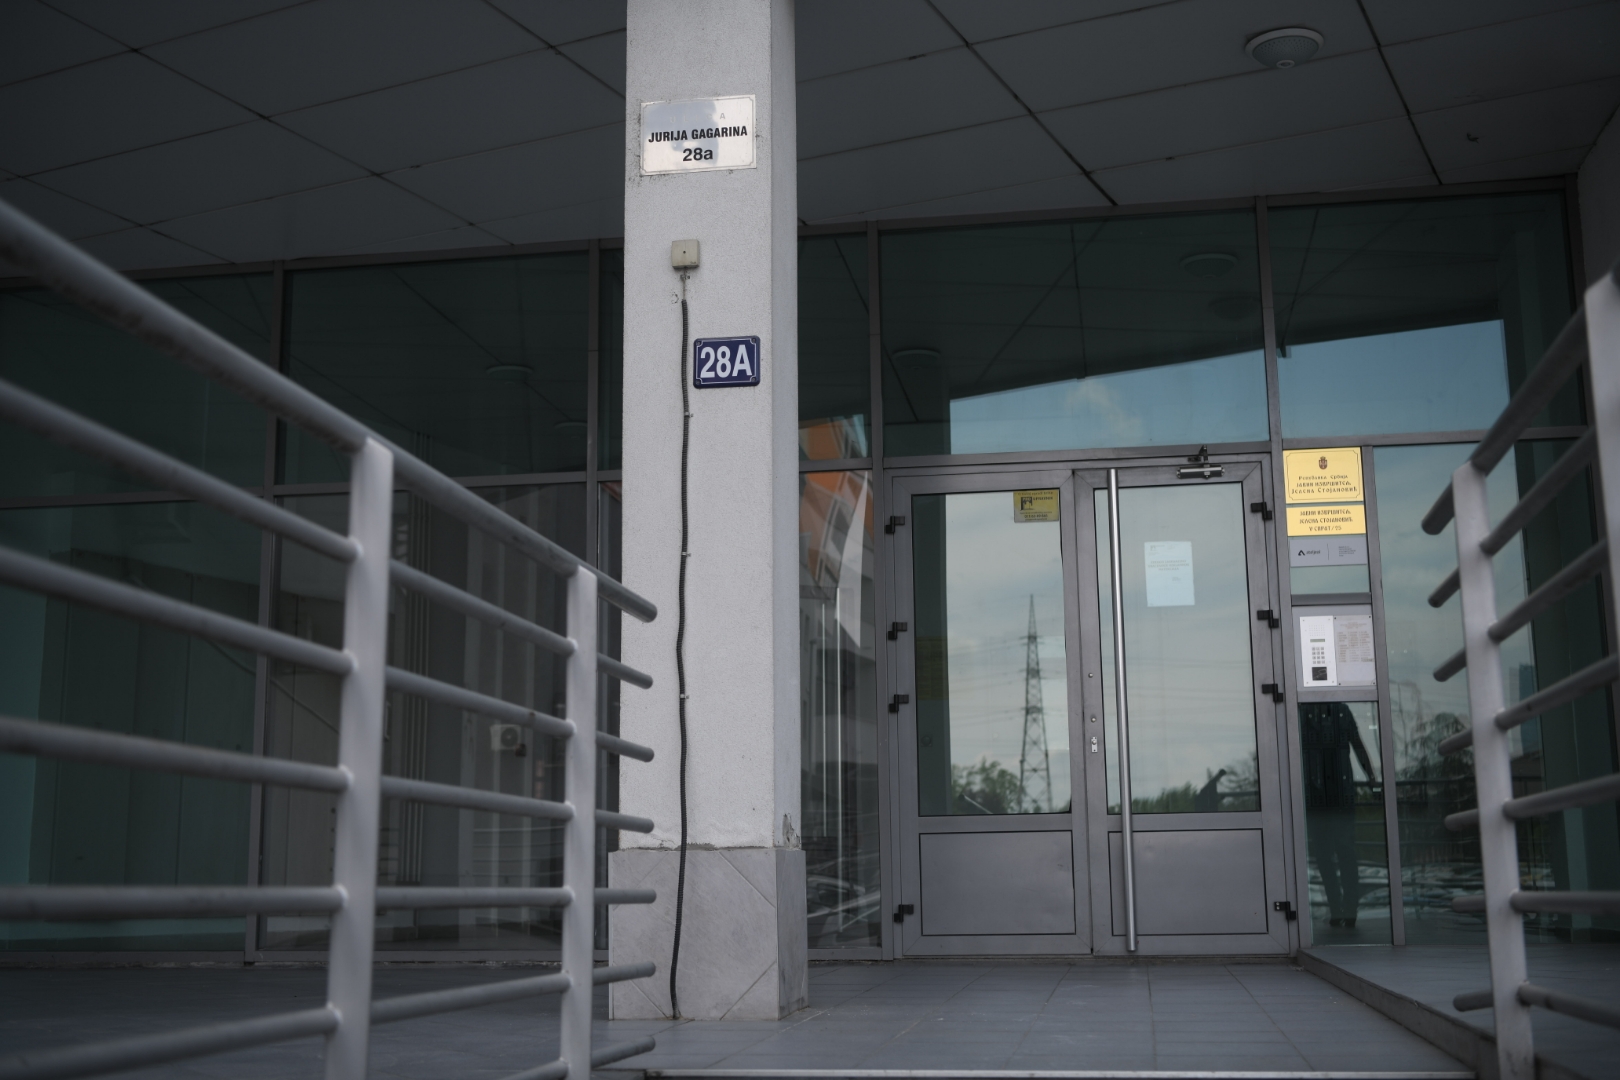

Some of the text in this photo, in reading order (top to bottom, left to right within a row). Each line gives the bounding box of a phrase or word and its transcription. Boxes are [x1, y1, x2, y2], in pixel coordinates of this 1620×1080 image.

[648, 125, 748, 143] JURIJA GAGARINA
[682, 147, 713, 162] 28a
[700, 344, 752, 378] 28A
